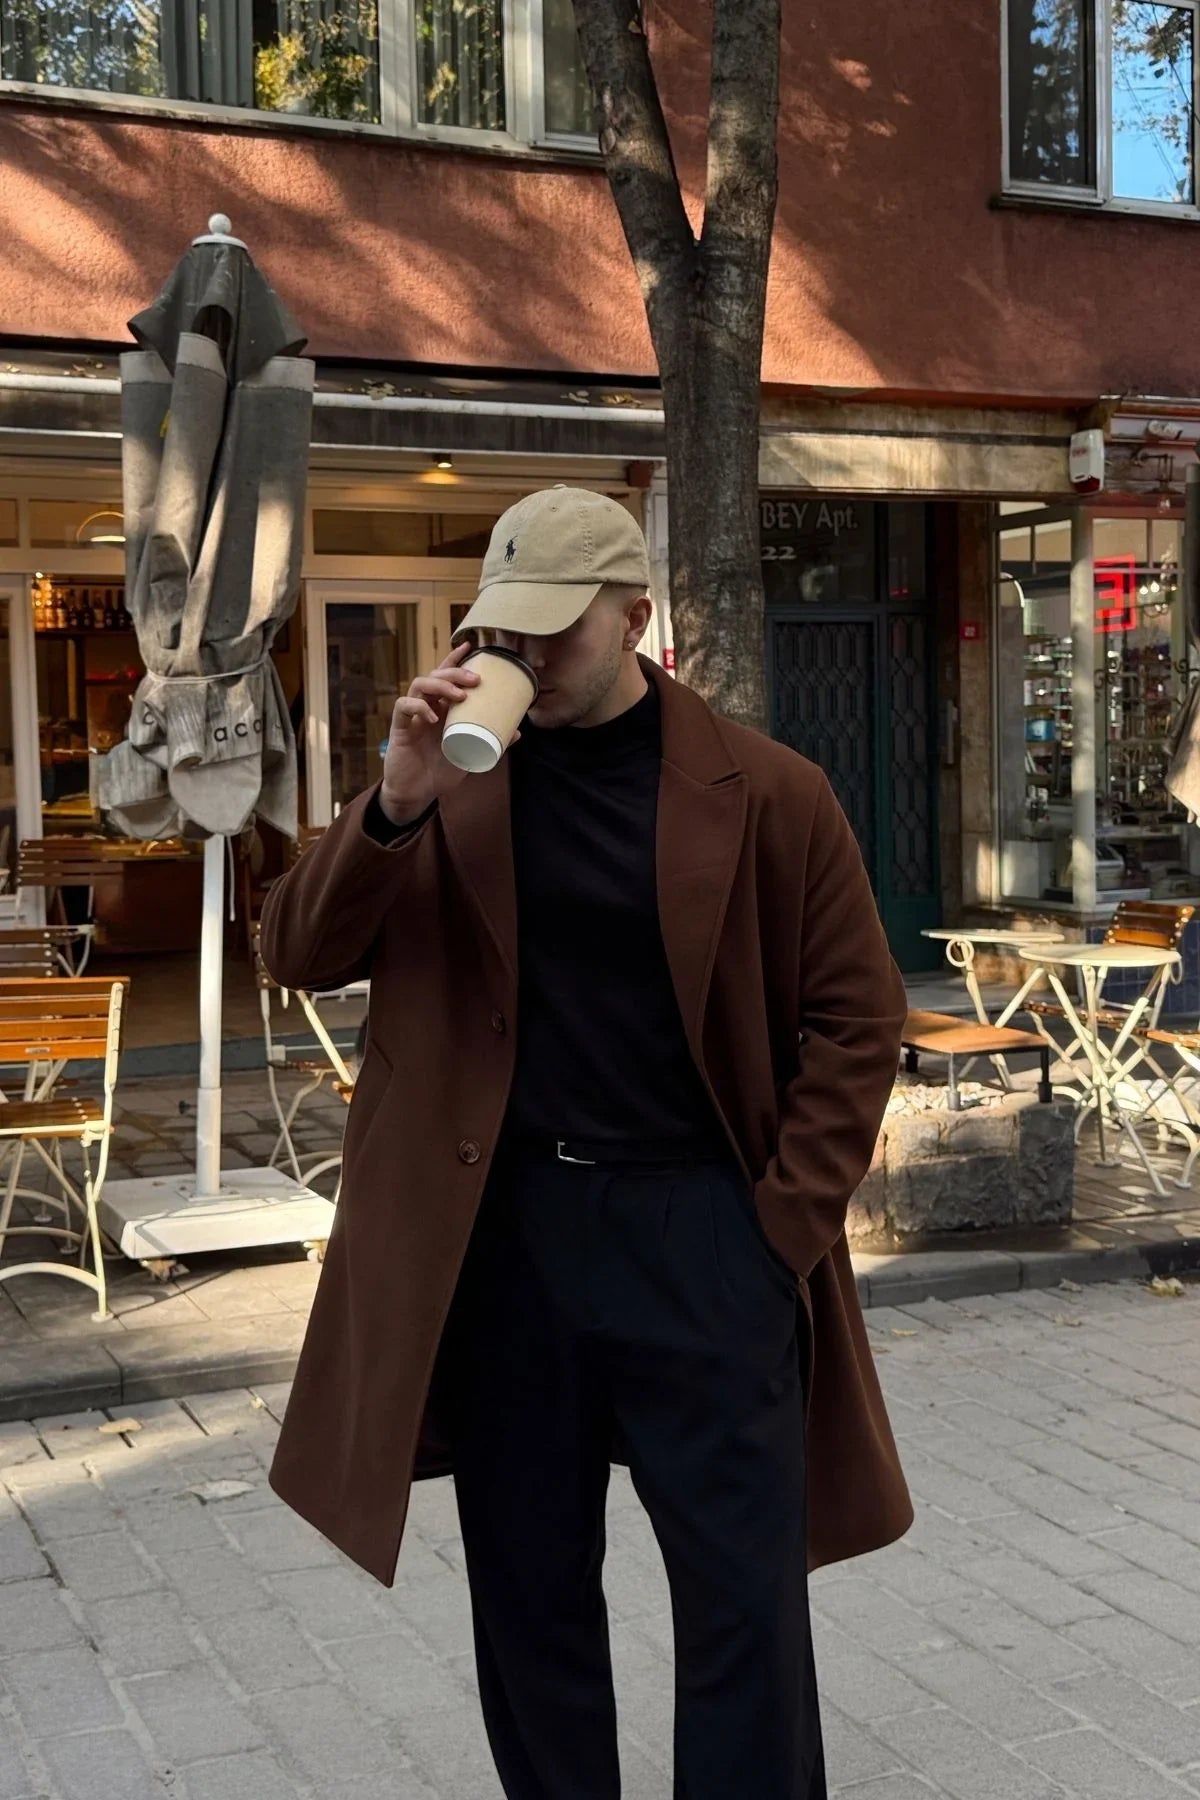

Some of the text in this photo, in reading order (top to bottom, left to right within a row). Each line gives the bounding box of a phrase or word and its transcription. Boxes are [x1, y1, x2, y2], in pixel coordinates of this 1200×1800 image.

[760, 501, 858, 537] BEY Apt.
[761, 546, 797, 560] 22
